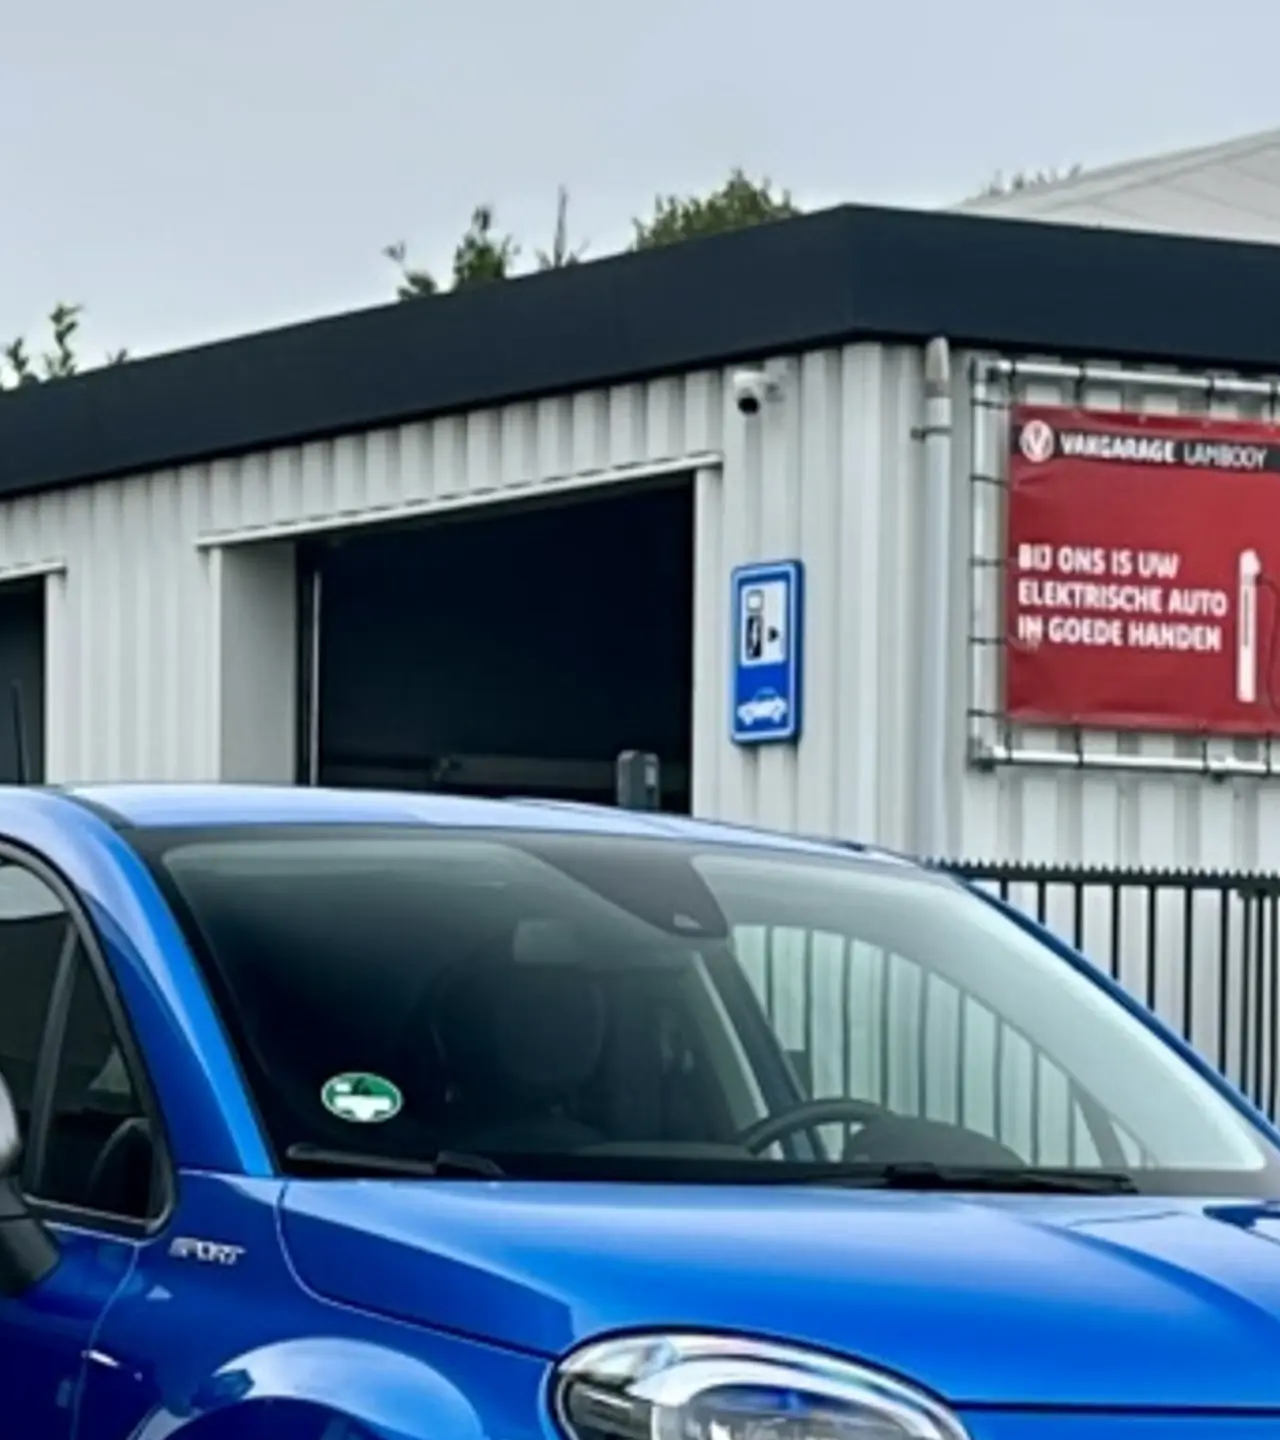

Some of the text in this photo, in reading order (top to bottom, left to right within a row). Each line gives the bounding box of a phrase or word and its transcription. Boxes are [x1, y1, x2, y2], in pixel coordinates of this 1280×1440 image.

[1059, 432, 1175, 463] VAKGARAGE
[1018, 543, 1179, 579] BIJ ONS IS UW
[1018, 578, 1228, 617] ELEKTRISCHE AUTO
[1018, 613, 1222, 652] IN GOEDE HANDEN
[168, 1236, 246, 1265] SPORT
